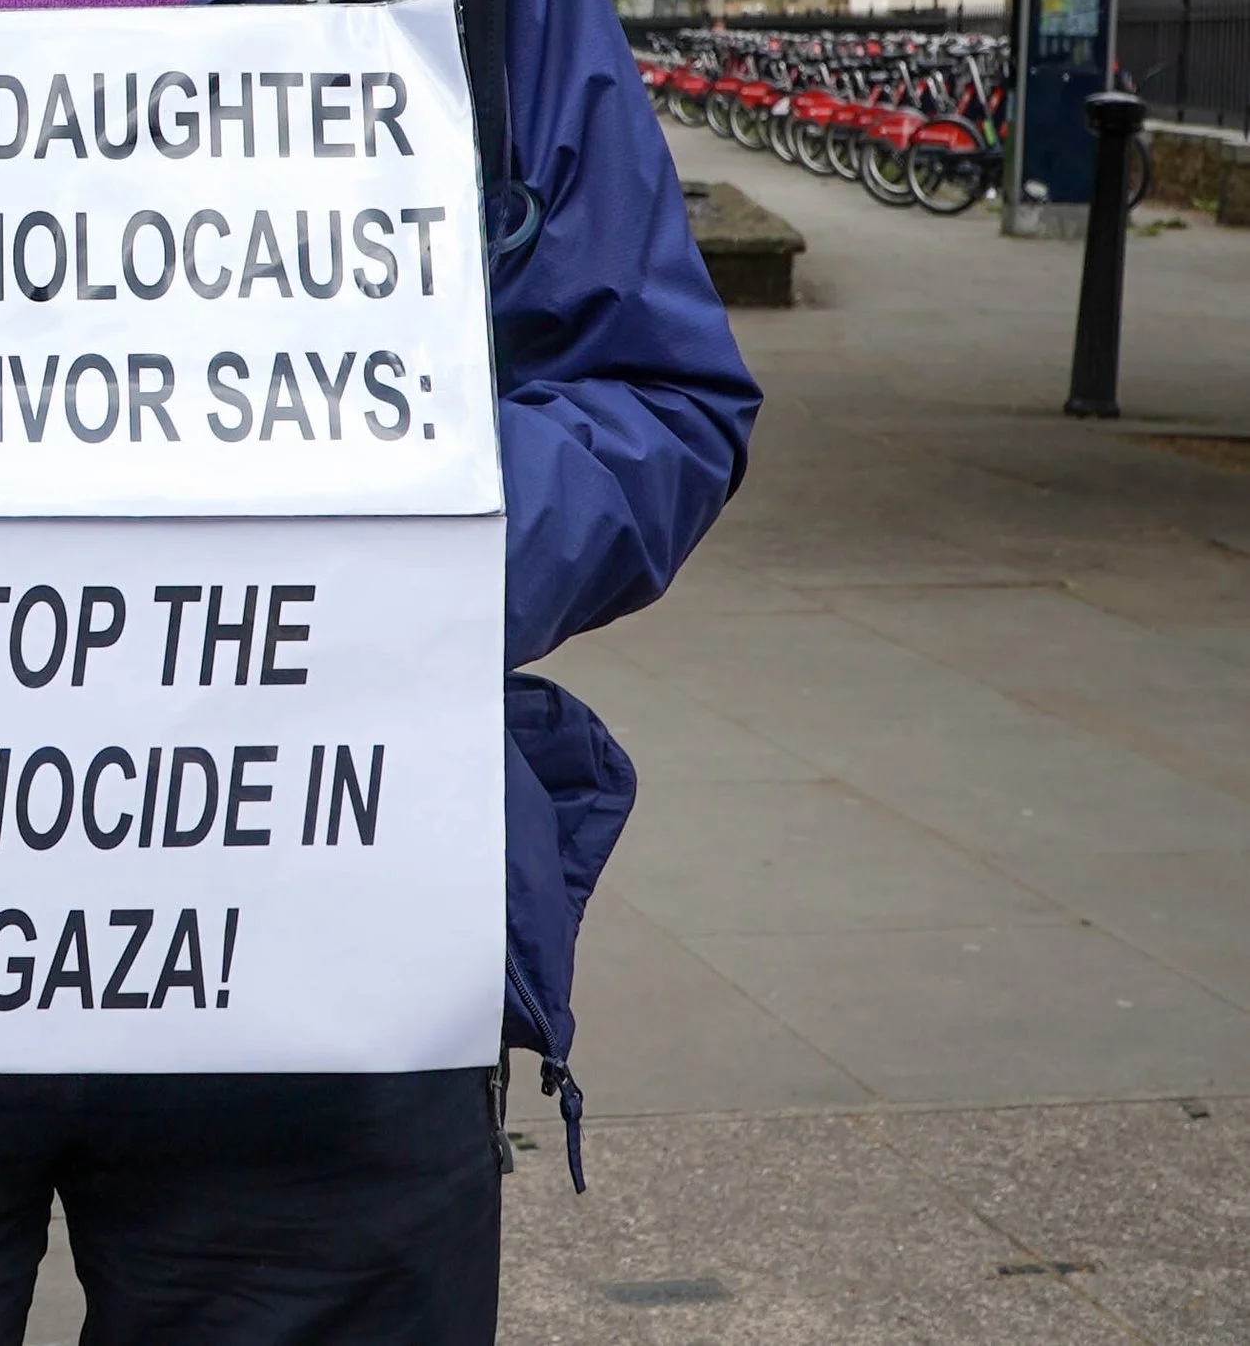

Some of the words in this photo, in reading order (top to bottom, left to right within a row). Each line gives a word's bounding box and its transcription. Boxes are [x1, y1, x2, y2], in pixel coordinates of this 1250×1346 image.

[206, 350, 436, 443] SAYS:
[153, 584, 317, 687] THE
[301, 744, 386, 847] IN
